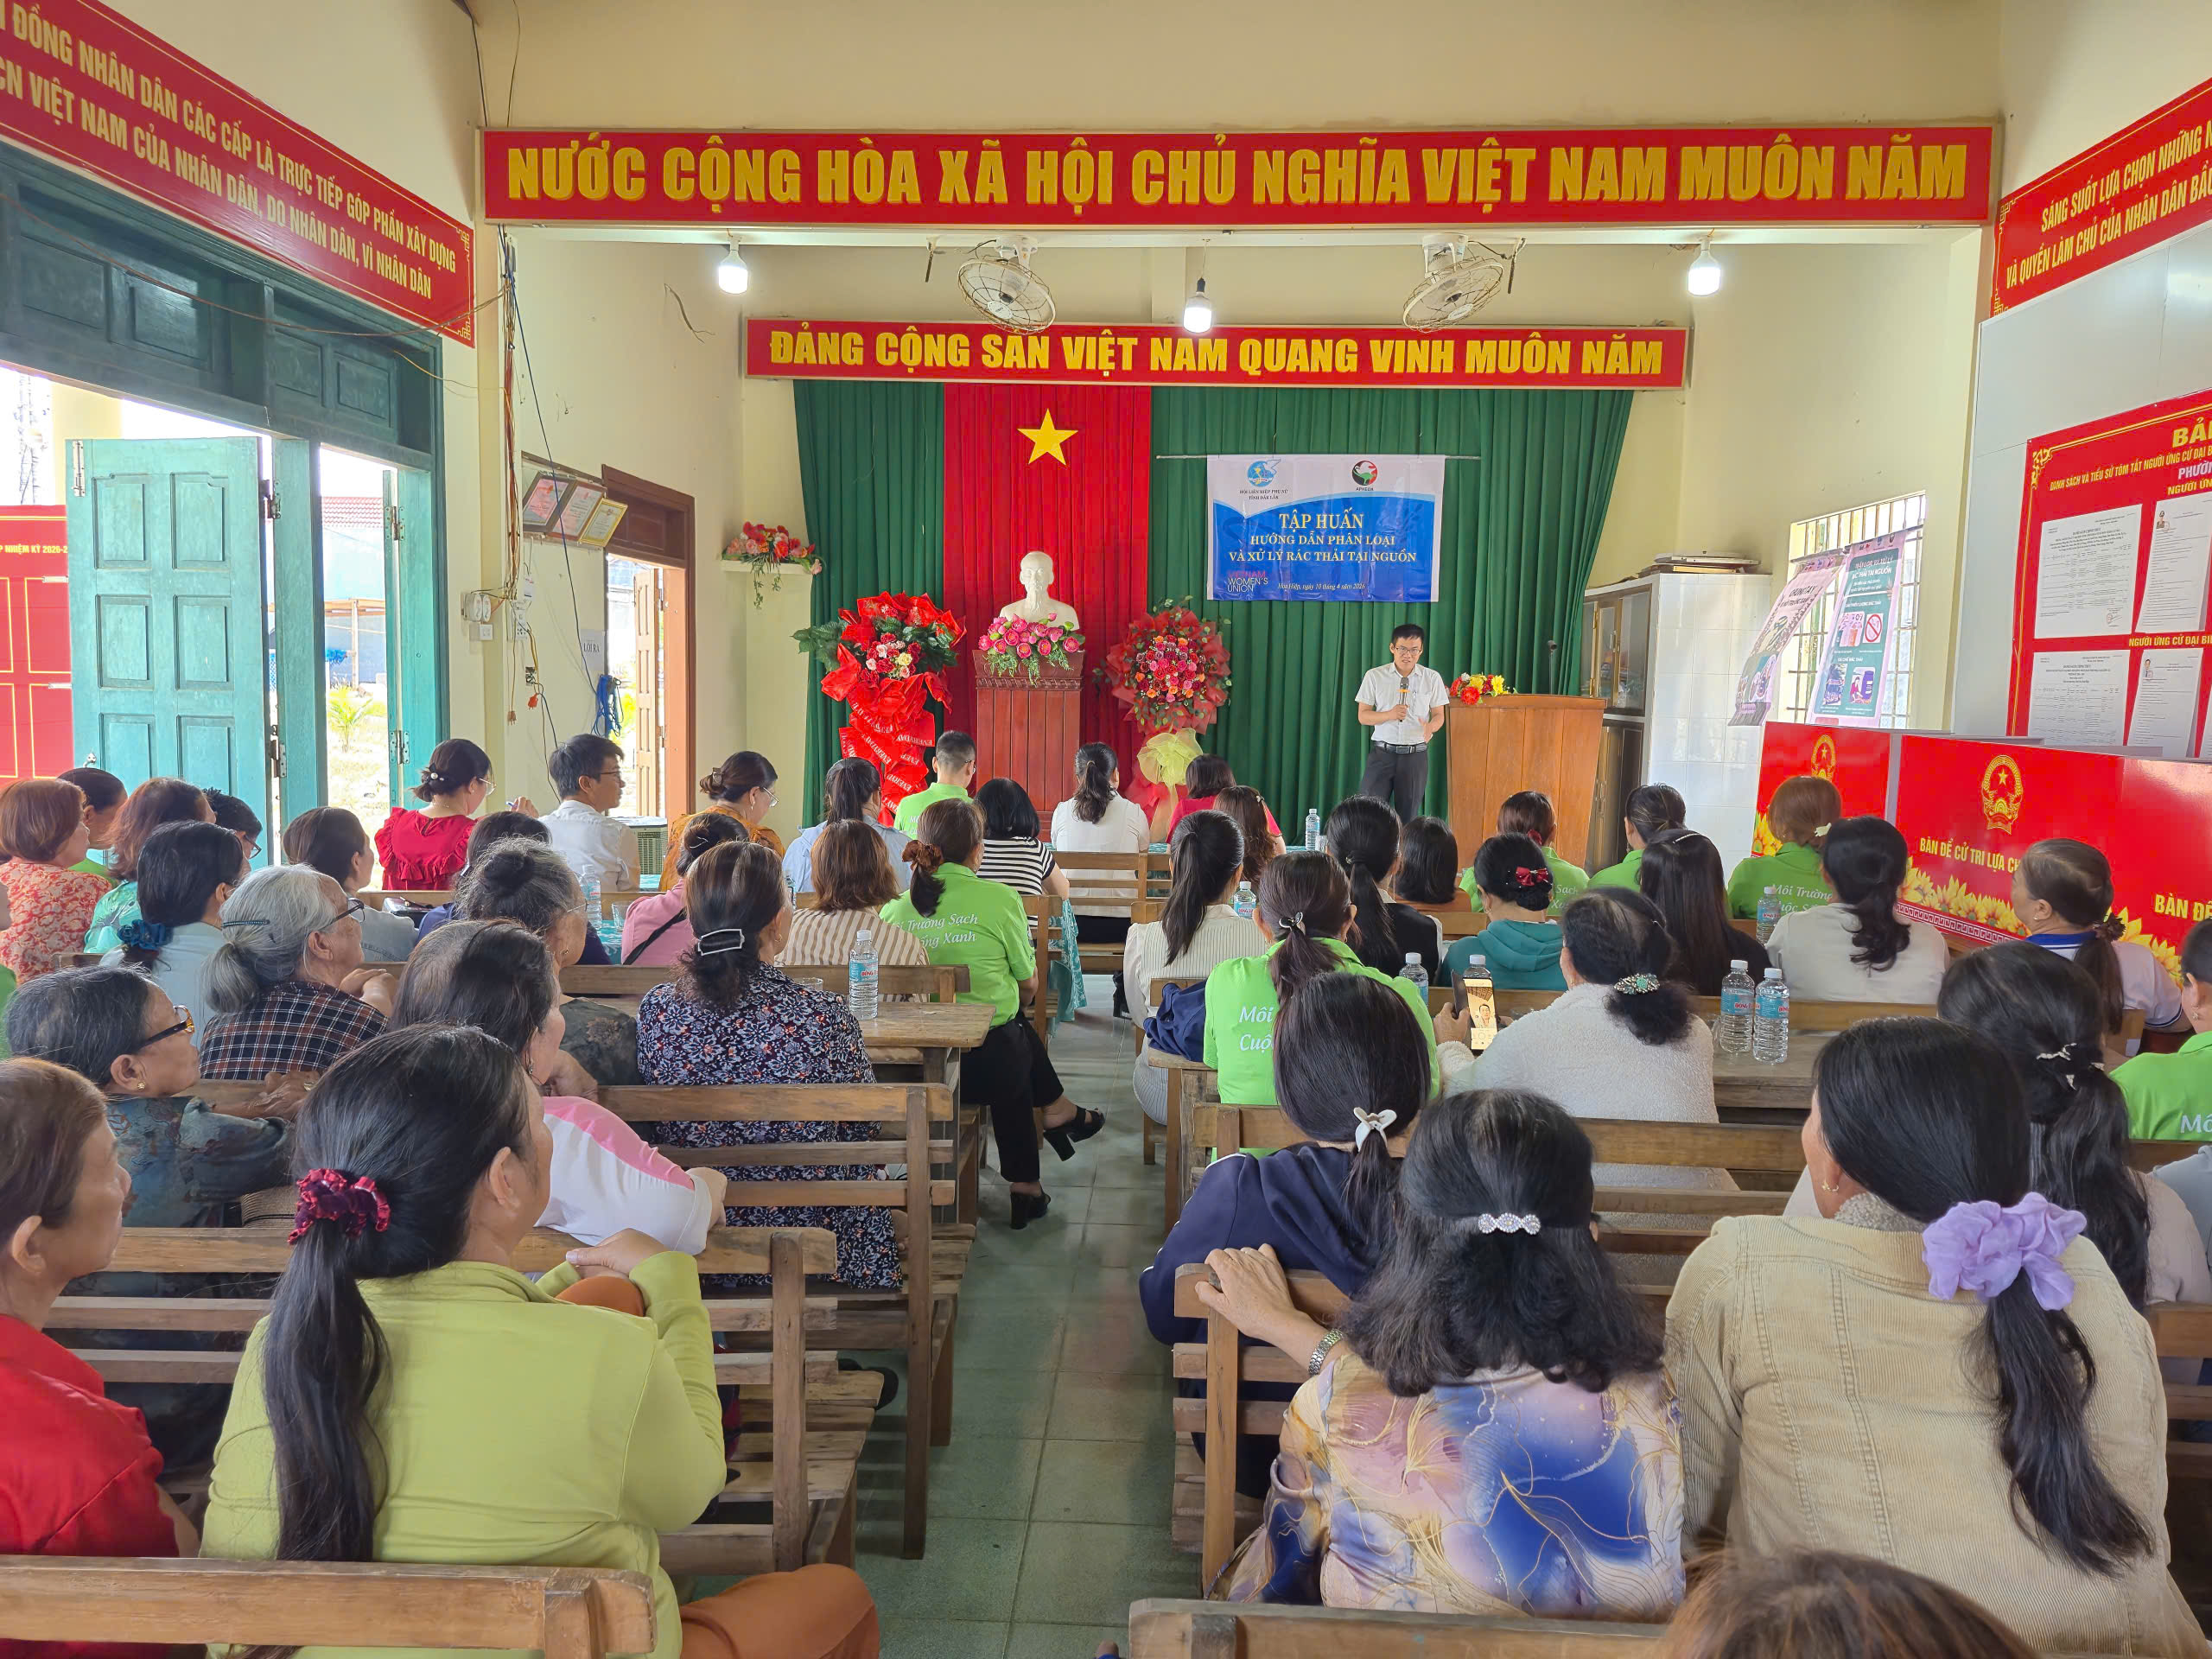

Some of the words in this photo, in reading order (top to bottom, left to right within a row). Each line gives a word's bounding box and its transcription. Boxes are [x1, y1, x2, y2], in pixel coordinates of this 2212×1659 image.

[13, 3, 73, 67] ĐỒNG
[79, 40, 134, 99] NHÂN
[139, 74, 178, 123] DÂN
[182, 99, 216, 143] CÁC
[221, 119, 251, 162] CẤP
[257, 140, 274, 175] LÀ
[277, 152, 312, 196] TRỰC
[316, 174, 343, 210] TIẾP
[346, 192, 370, 226] GÓP
[373, 207, 404, 245] PHẦN
[406, 225, 426, 257] XÂY
[429, 238, 456, 274] DỰNG
[507, 131, 645, 201] NƯỚC
[662, 135, 801, 214] CỘNG
[817, 137, 922, 204] HÒA
[938, 138, 1009, 204] XÃ
[1026, 137, 1114, 215] HỘI
[1131, 133, 1236, 206] CHỦ
[1252, 137, 1411, 205] NGHĨA
[1422, 137, 1536, 214] VIỆT
[1548, 146, 1668, 203] NAM
[1678, 133, 1834, 202] MUÔN
[1846, 133, 1967, 202] NĂM
[2041, 200, 2069, 232] SÁNG
[2070, 175, 2098, 219] SUỐT
[2099, 168, 2120, 206] LỰA
[2124, 149, 2156, 189] CHỌN
[2158, 129, 2202, 174] NHỮNG
[29, 71, 74, 125] VIỆT
[80, 98, 128, 151] NAM
[133, 123, 171, 173] CỦA
[175, 146, 222, 191] NHÂN
[227, 172, 263, 221] DÂN,
[266, 194, 286, 228] DO
[289, 205, 327, 249] NHÂN
[330, 226, 359, 267] DÂN,
[362, 241, 373, 270] VÌ
[376, 253, 408, 288] NHÂN
[410, 268, 431, 299] DÂN
[2005, 260, 2018, 289] VÀ
[2051, 234, 2074, 269] LÀM
[2075, 217, 2098, 257] CHỦ
[2100, 208, 2121, 245] CỦA
[2124, 194, 2158, 235] NHÂN
[2161, 180, 2188, 218] DÂN
[770, 321, 864, 366] ĐẢNG
[875, 326, 970, 374] CỘNG
[1061, 328, 1139, 378] VIỆT
[1149, 338, 1228, 372] NAM
[1239, 338, 1358, 377] QUANG
[1370, 340, 1453, 374] VINH
[1465, 332, 1572, 374] MUÔN
[1581, 334, 1662, 374] NĂM
[2050, 479, 2066, 492] DANH
[1279, 509, 1312, 533] TẬP
[1315, 507, 1364, 530] HUẤN
[1250, 532, 1295, 545] HƯỚNG
[1298, 531, 1325, 545] DẪN
[1327, 532, 1362, 545] PHÂN
[1365, 535, 1395, 548] LOẠI
[1229, 550, 1245, 562] VÀ
[1247, 548, 1266, 562] XỬ
[1268, 549, 1284, 562] LÝ
[1286, 549, 1311, 562] RÁC
[1313, 548, 1344, 562] THẢI
[1347, 551, 1369, 563] TẠI
[1370, 548, 1417, 563] NGUỒN
[2128, 638, 2152, 648] NGƯỜI
[2153, 635, 2171, 646] ỨNG
[2185, 635, 2199, 647] ĐẠI
[896, 734, 933, 747] EVERYDAY
[1919, 836, 1938, 855] BÀN
[1940, 838, 1954, 858] ĐỂ
[1955, 842, 1968, 861] CỬ
[1970, 848, 1986, 866] TRI
[1986, 852, 2005, 873] LỰA
[2154, 892, 2189, 918] BÀN
[907, 917, 945, 932] Trường
[948, 913, 978, 926] Sạch
[943, 930, 976, 944] Xanh
[1238, 1005, 1274, 1023] Môi
[1239, 1033, 1274, 1054] Cuộ
